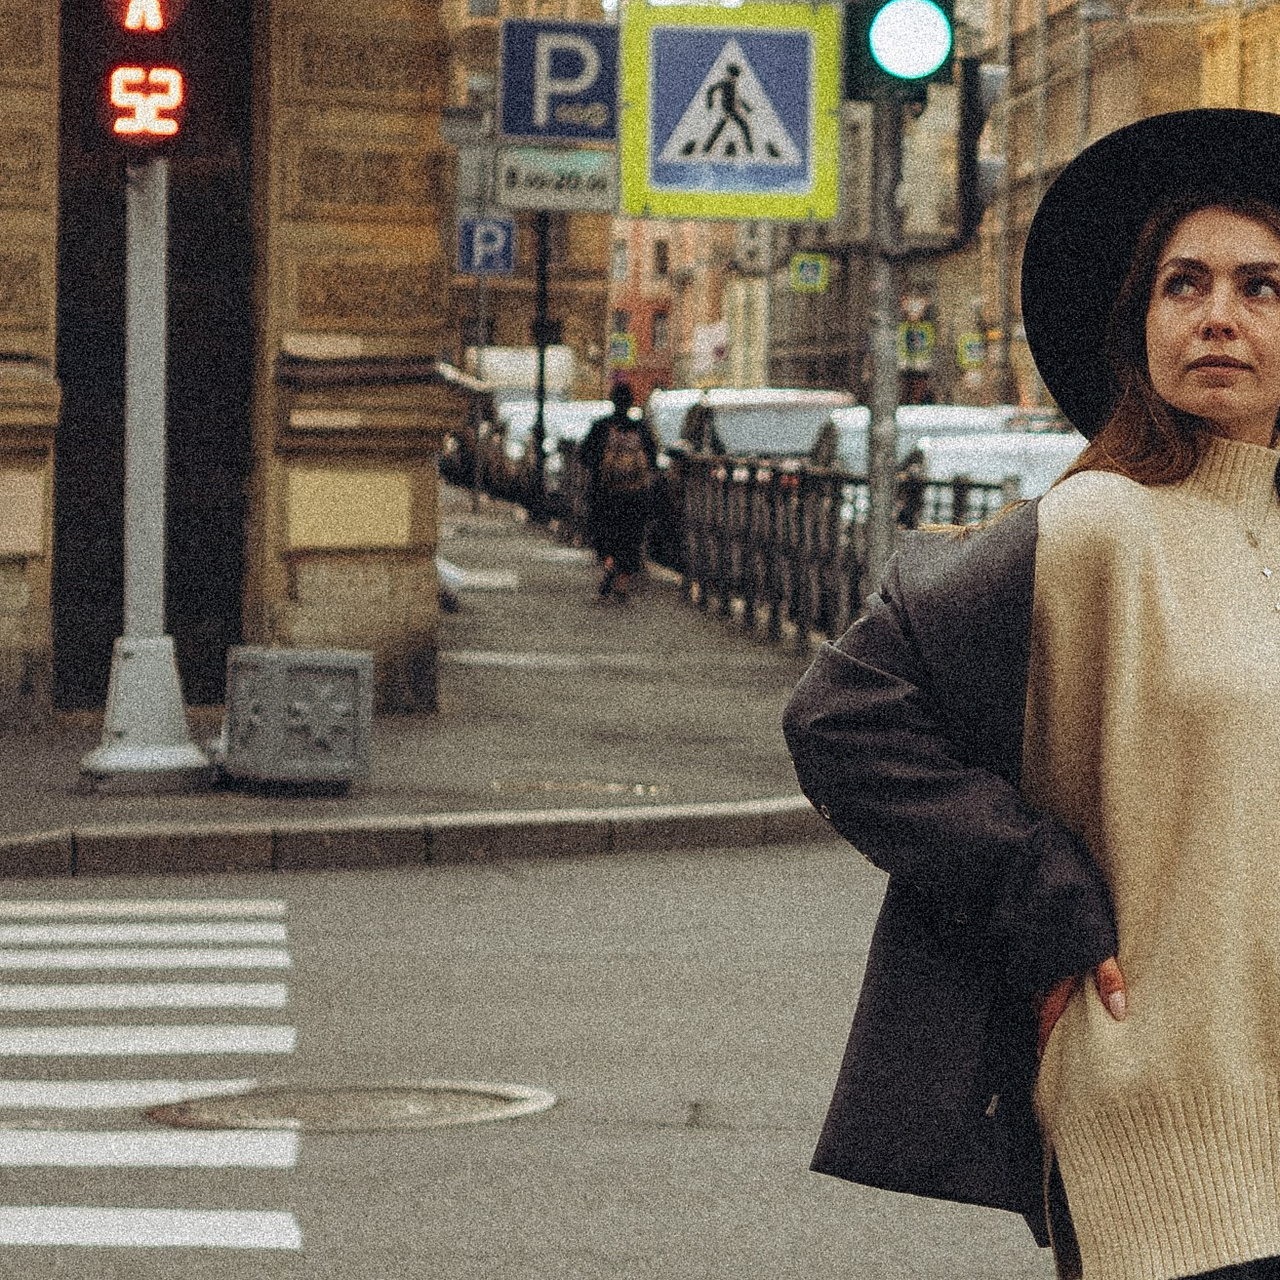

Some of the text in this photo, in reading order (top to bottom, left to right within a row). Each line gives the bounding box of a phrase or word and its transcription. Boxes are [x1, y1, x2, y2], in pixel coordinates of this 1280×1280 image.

[110, 67, 183, 136] 52
[533, 32, 602, 126] P
[473, 224, 506, 267] P
